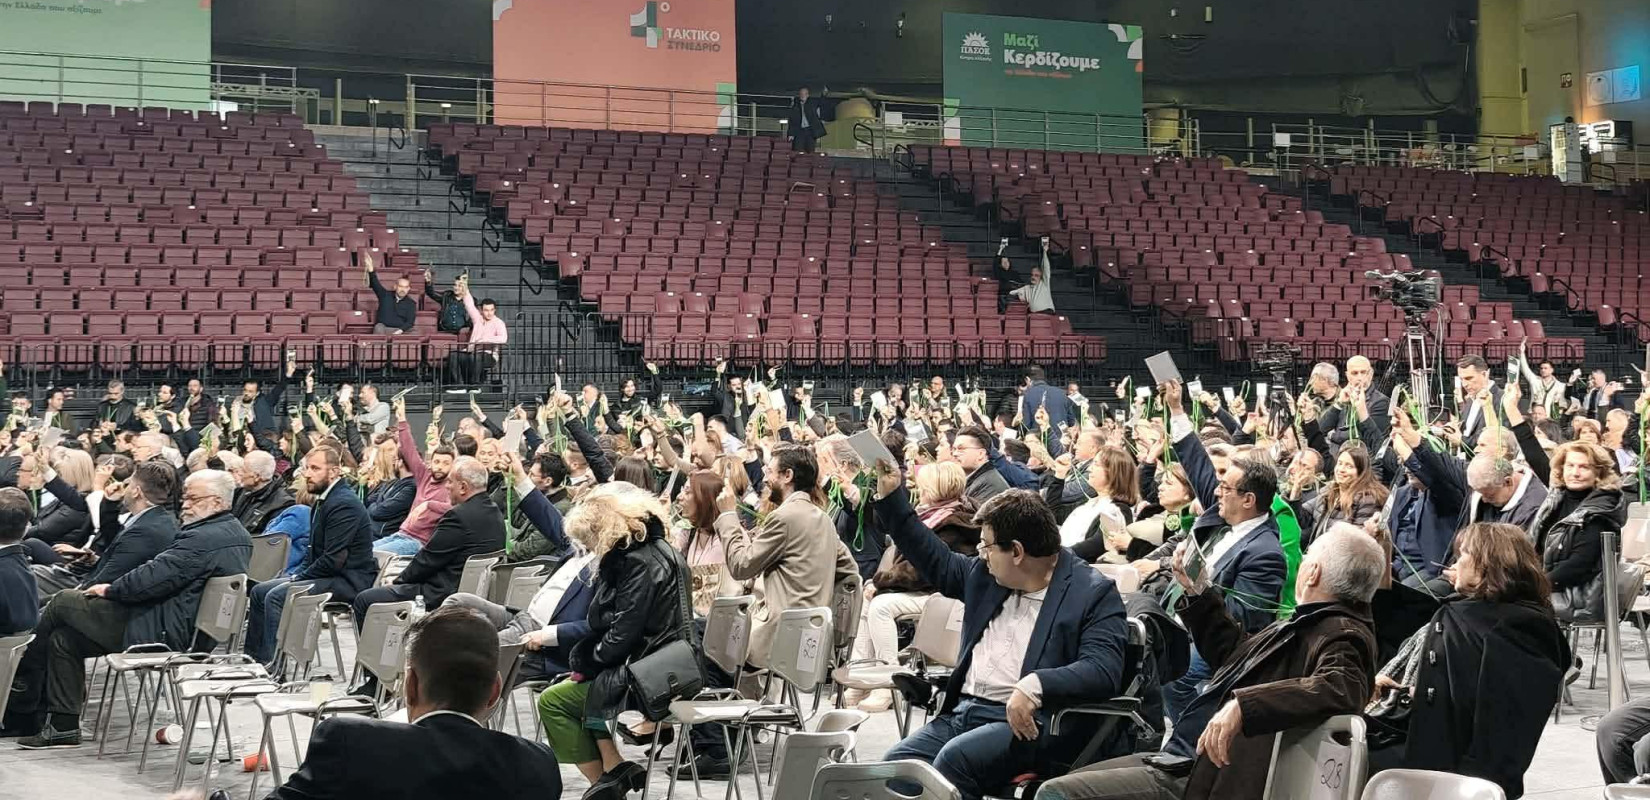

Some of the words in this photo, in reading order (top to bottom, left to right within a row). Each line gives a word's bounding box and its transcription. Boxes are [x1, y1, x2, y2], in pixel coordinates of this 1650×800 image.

[666, 28, 720, 41] ΤΑΚΤΙΚΟ
[1004, 32, 1039, 50] Μαζί
[667, 40, 721, 52] ΣΥΝΕΔΡΙΟ
[960, 46, 991, 55] ΠΑΣΟΚ
[1004, 49, 1100, 71] Κερδίζουμε
[1320, 758, 1343, 789] 28
